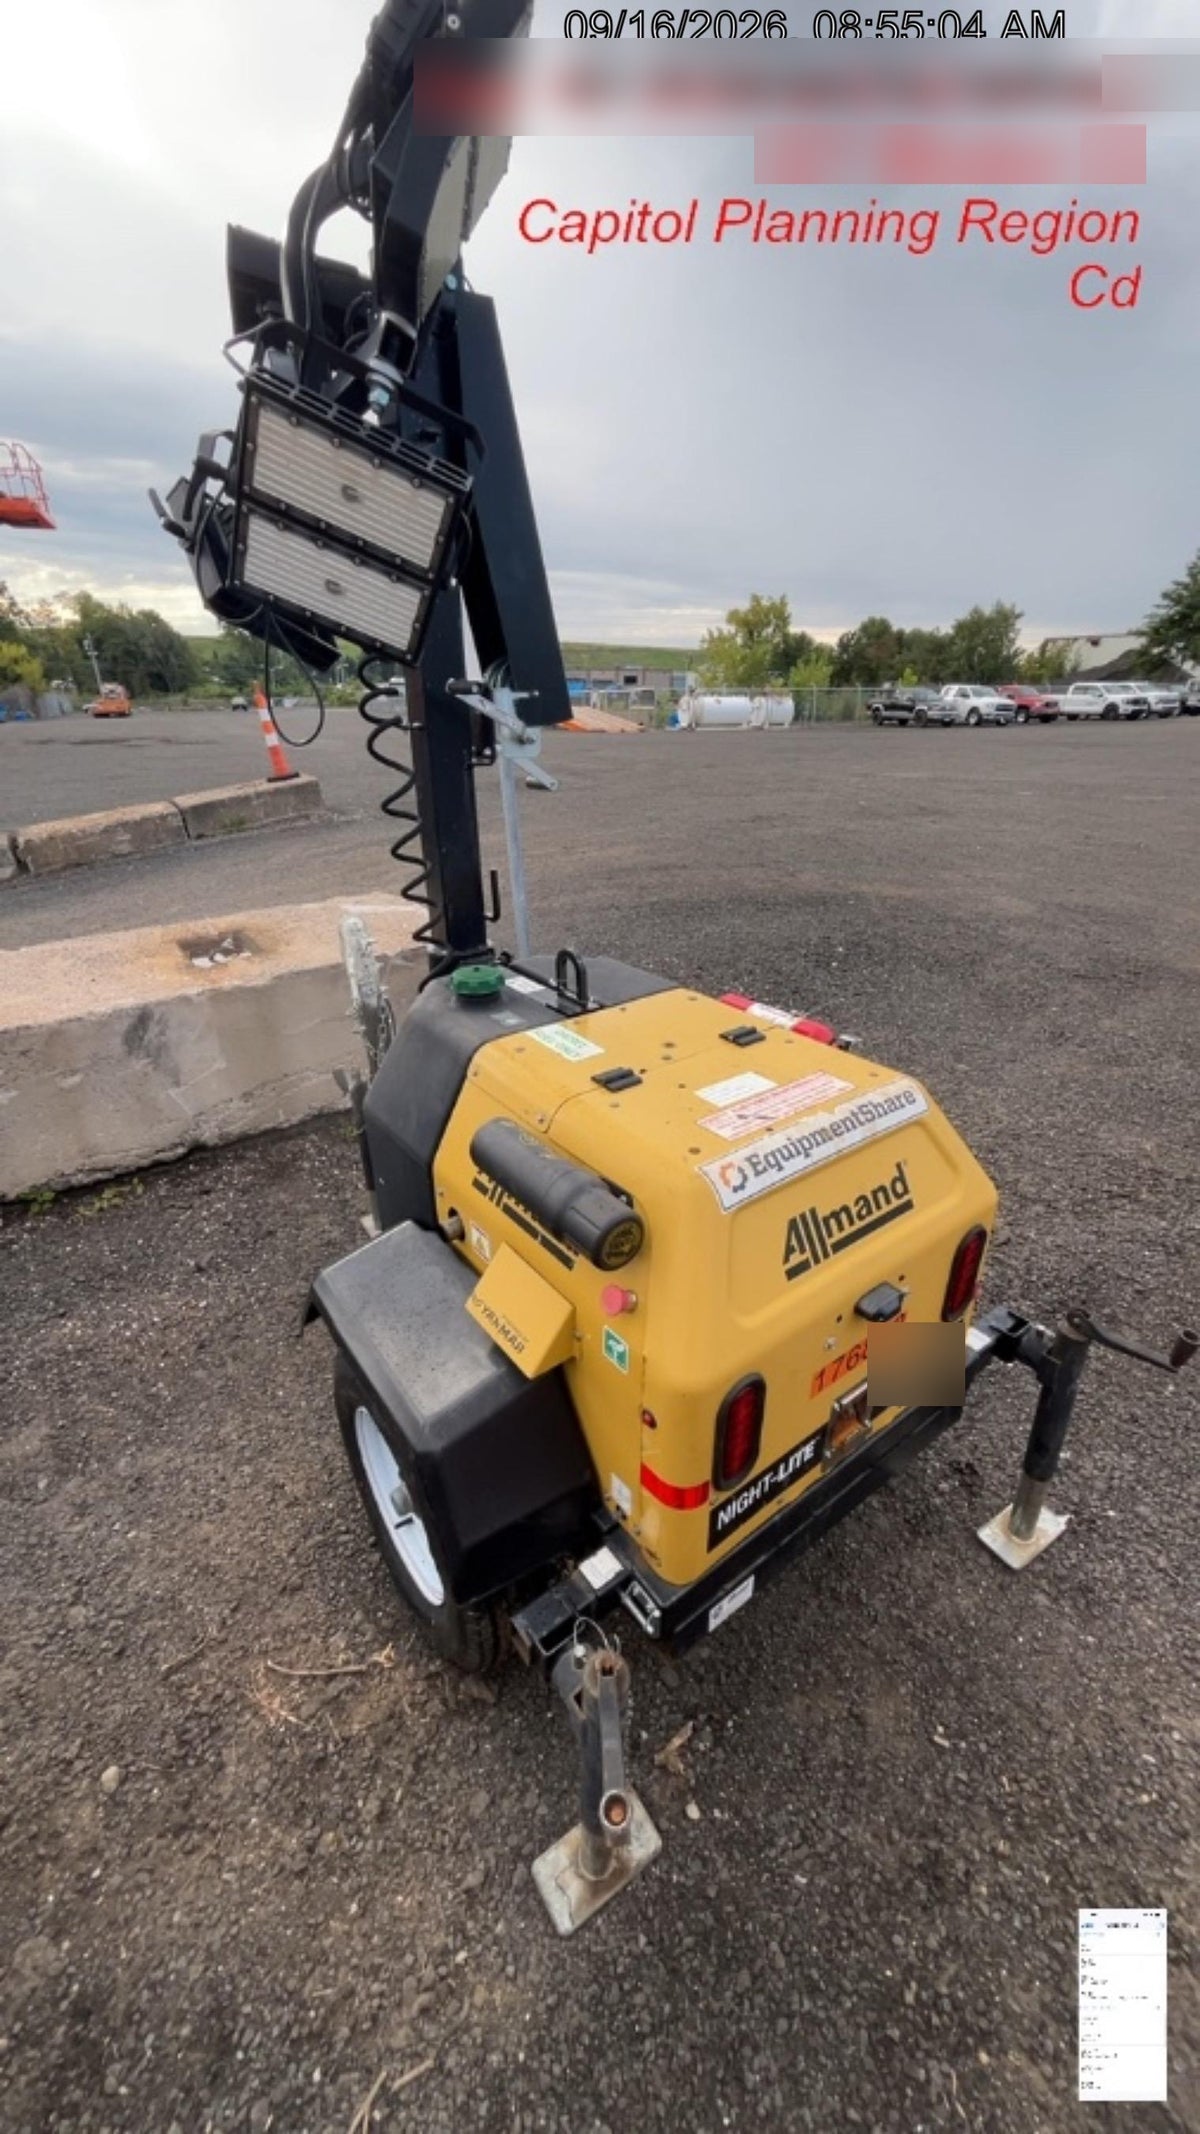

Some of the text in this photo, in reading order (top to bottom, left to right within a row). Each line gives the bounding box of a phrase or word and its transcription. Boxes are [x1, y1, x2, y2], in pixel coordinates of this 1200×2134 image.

[745, 1086, 918, 1180] EquipmentShare
[777, 1160, 910, 1266] Allmand
[716, 1439, 816, 1531] NIGHT-LITE
